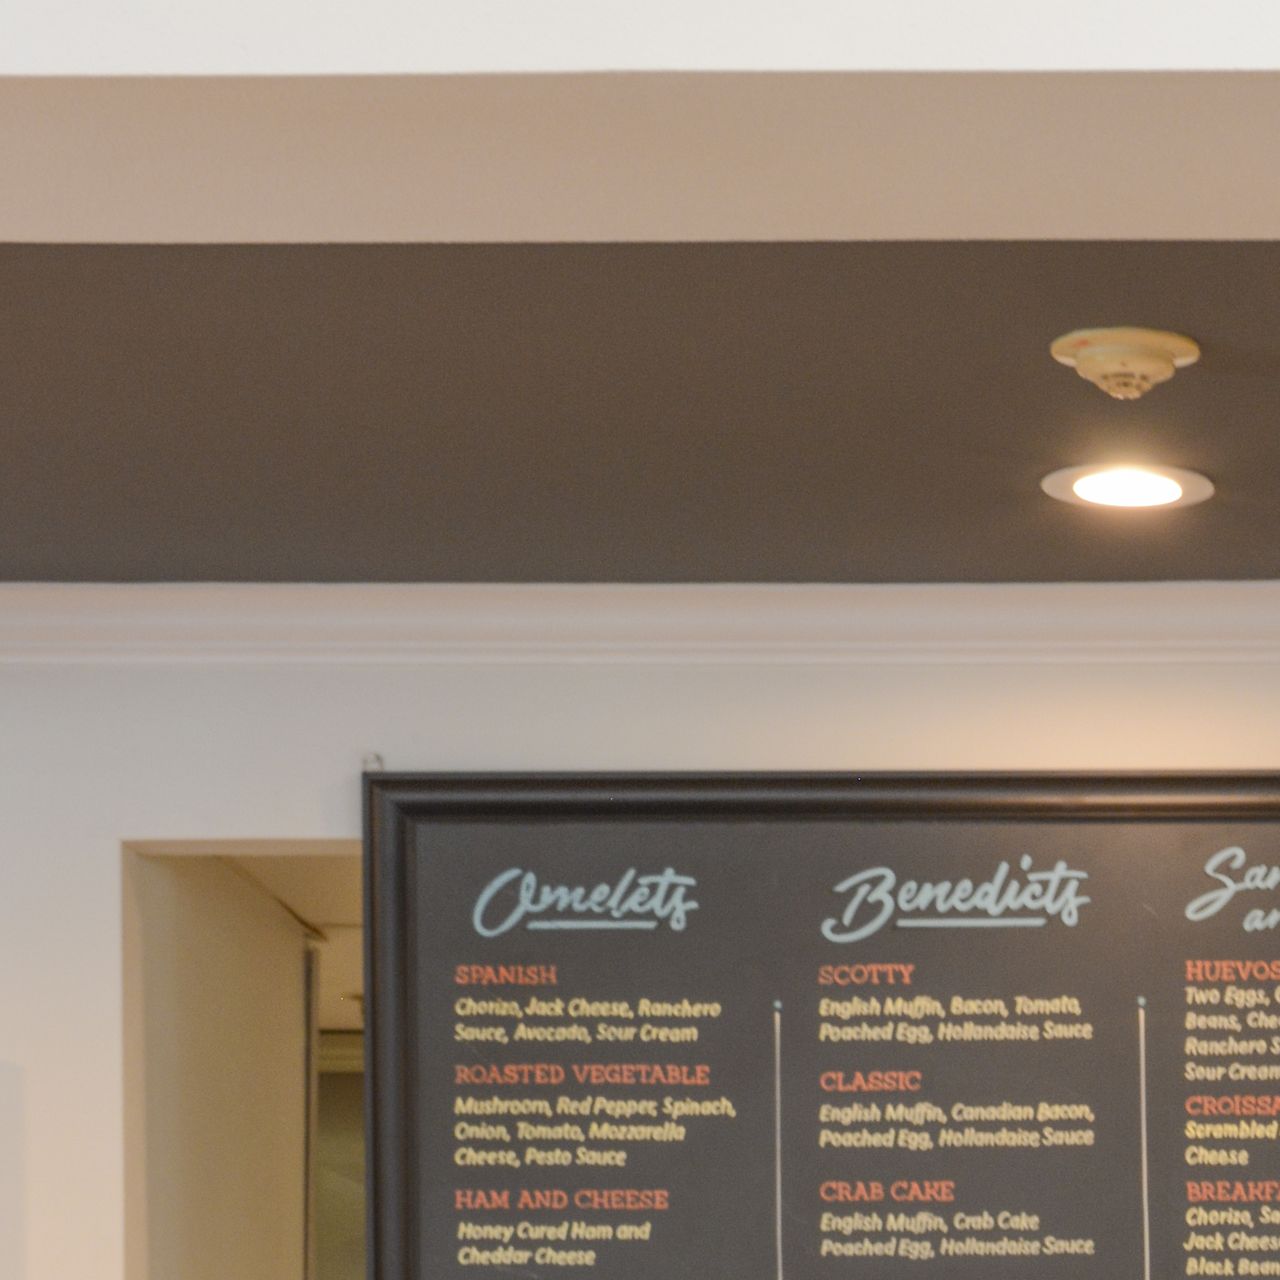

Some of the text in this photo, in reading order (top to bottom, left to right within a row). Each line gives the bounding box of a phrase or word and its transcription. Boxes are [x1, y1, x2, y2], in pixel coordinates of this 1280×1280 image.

[472, 867, 699, 937] Omelets
[821, 854, 1091, 943] Benedicts
[454, 965, 557, 985] SPANISH
[818, 962, 915, 986] SCOTTY
[455, 996, 721, 1020] Chorizo, Jack Cheese, Ranchero
[818, 995, 1081, 1020] English Muffin, Bacon, Tomato,
[454, 1022, 699, 1044] Sauce, Avocado, Sour Cream
[819, 1019, 1094, 1044] Poached Egg, Hollandaise Sauce
[455, 1064, 711, 1086] ROASTED VEGETABLE
[819, 1071, 922, 1092] CLASSIC
[1184, 1061, 1227, 1081] Sour
[454, 1095, 736, 1120] Mushroom, Red Pepper, Spinach,
[819, 1101, 1095, 1126] English Muffin, Canadian Bacon,
[454, 1121, 686, 1142] Onion, Tomato, Mozzarella
[454, 1146, 627, 1168] Cheese, Pesto Sauce
[1185, 1145, 1249, 1166] Cheese
[455, 1189, 670, 1211] HAM AND CHEESE
[819, 1180, 955, 1202] CRAB CAKE
[457, 1221, 651, 1243] Honey Cured Ham and
[820, 1210, 1040, 1236] English Muffin, Crab Cake
[457, 1246, 596, 1266] Cheddar Cheese
